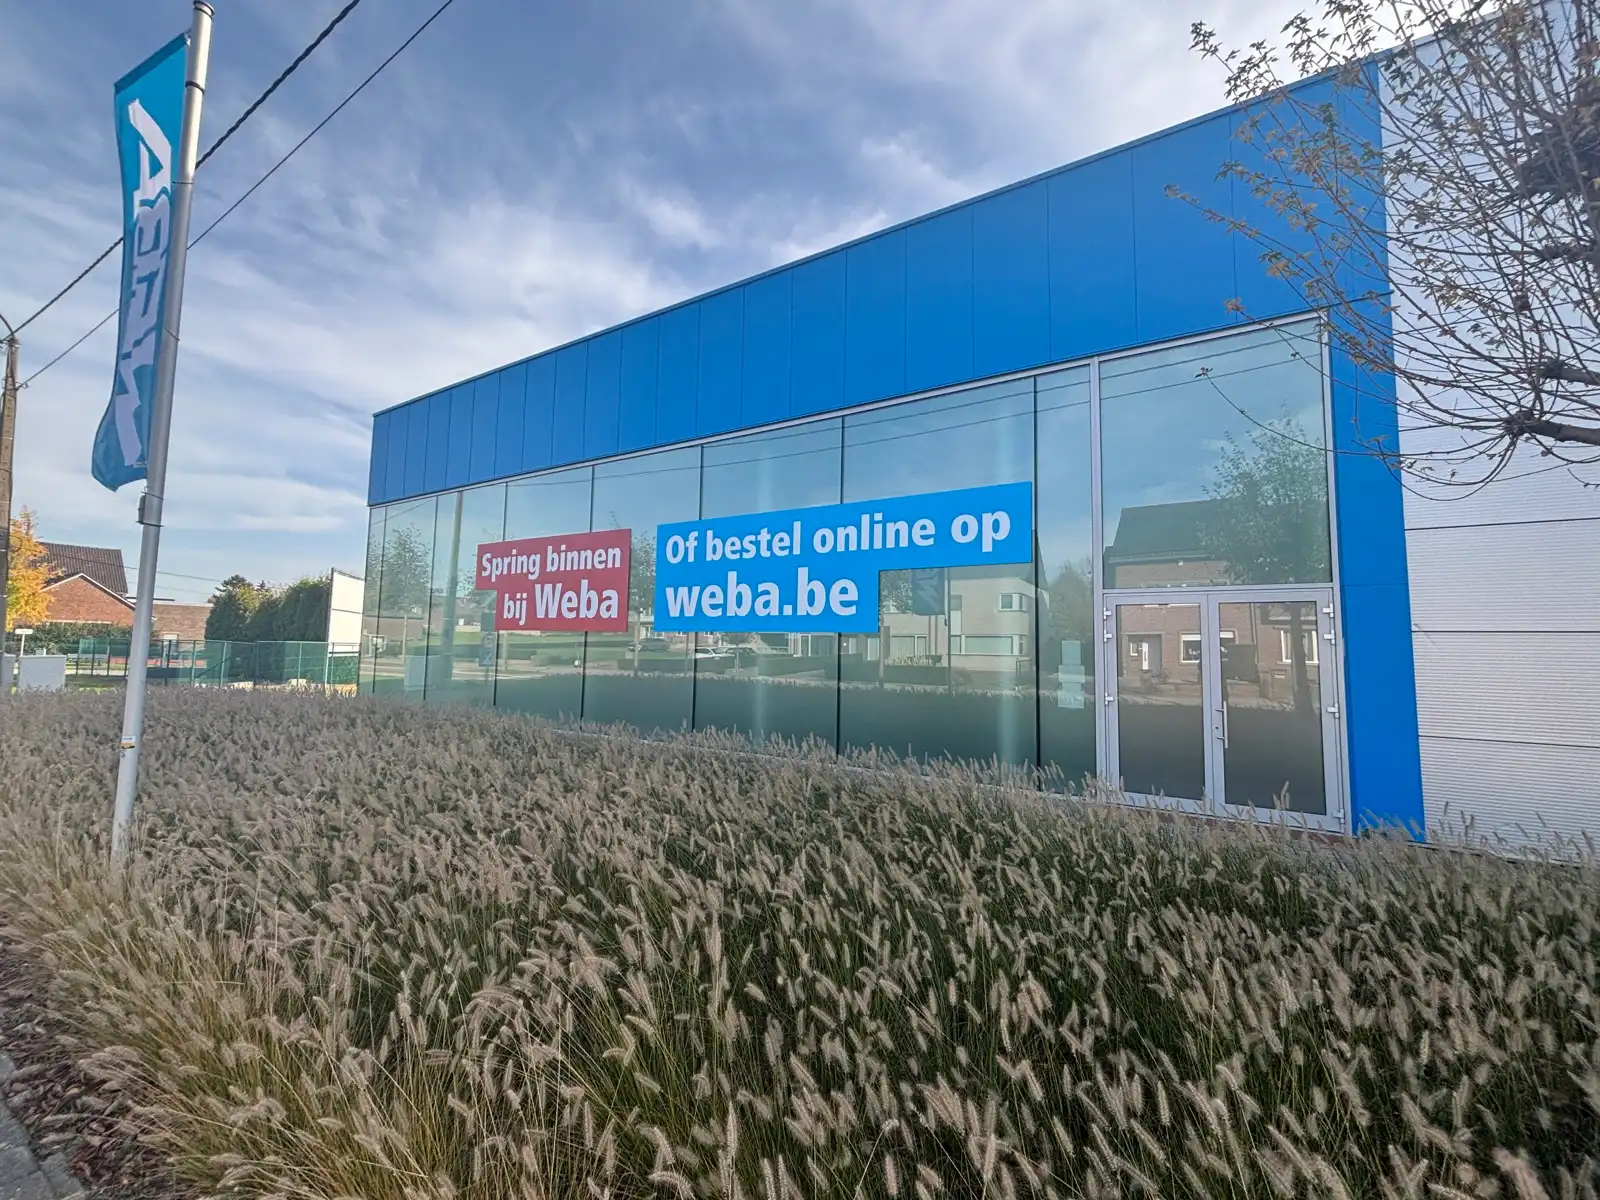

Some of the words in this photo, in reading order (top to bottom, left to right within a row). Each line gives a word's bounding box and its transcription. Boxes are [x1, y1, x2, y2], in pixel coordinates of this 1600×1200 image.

[666, 531, 699, 563] Of
[706, 521, 801, 561] bestel
[813, 512, 936, 553] online
[951, 510, 1011, 552] op
[481, 549, 541, 582] Spring
[546, 544, 621, 572] binnen
[503, 593, 527, 626] bij
[535, 579, 619, 620] Weba
[665, 567, 859, 617] weba.be
